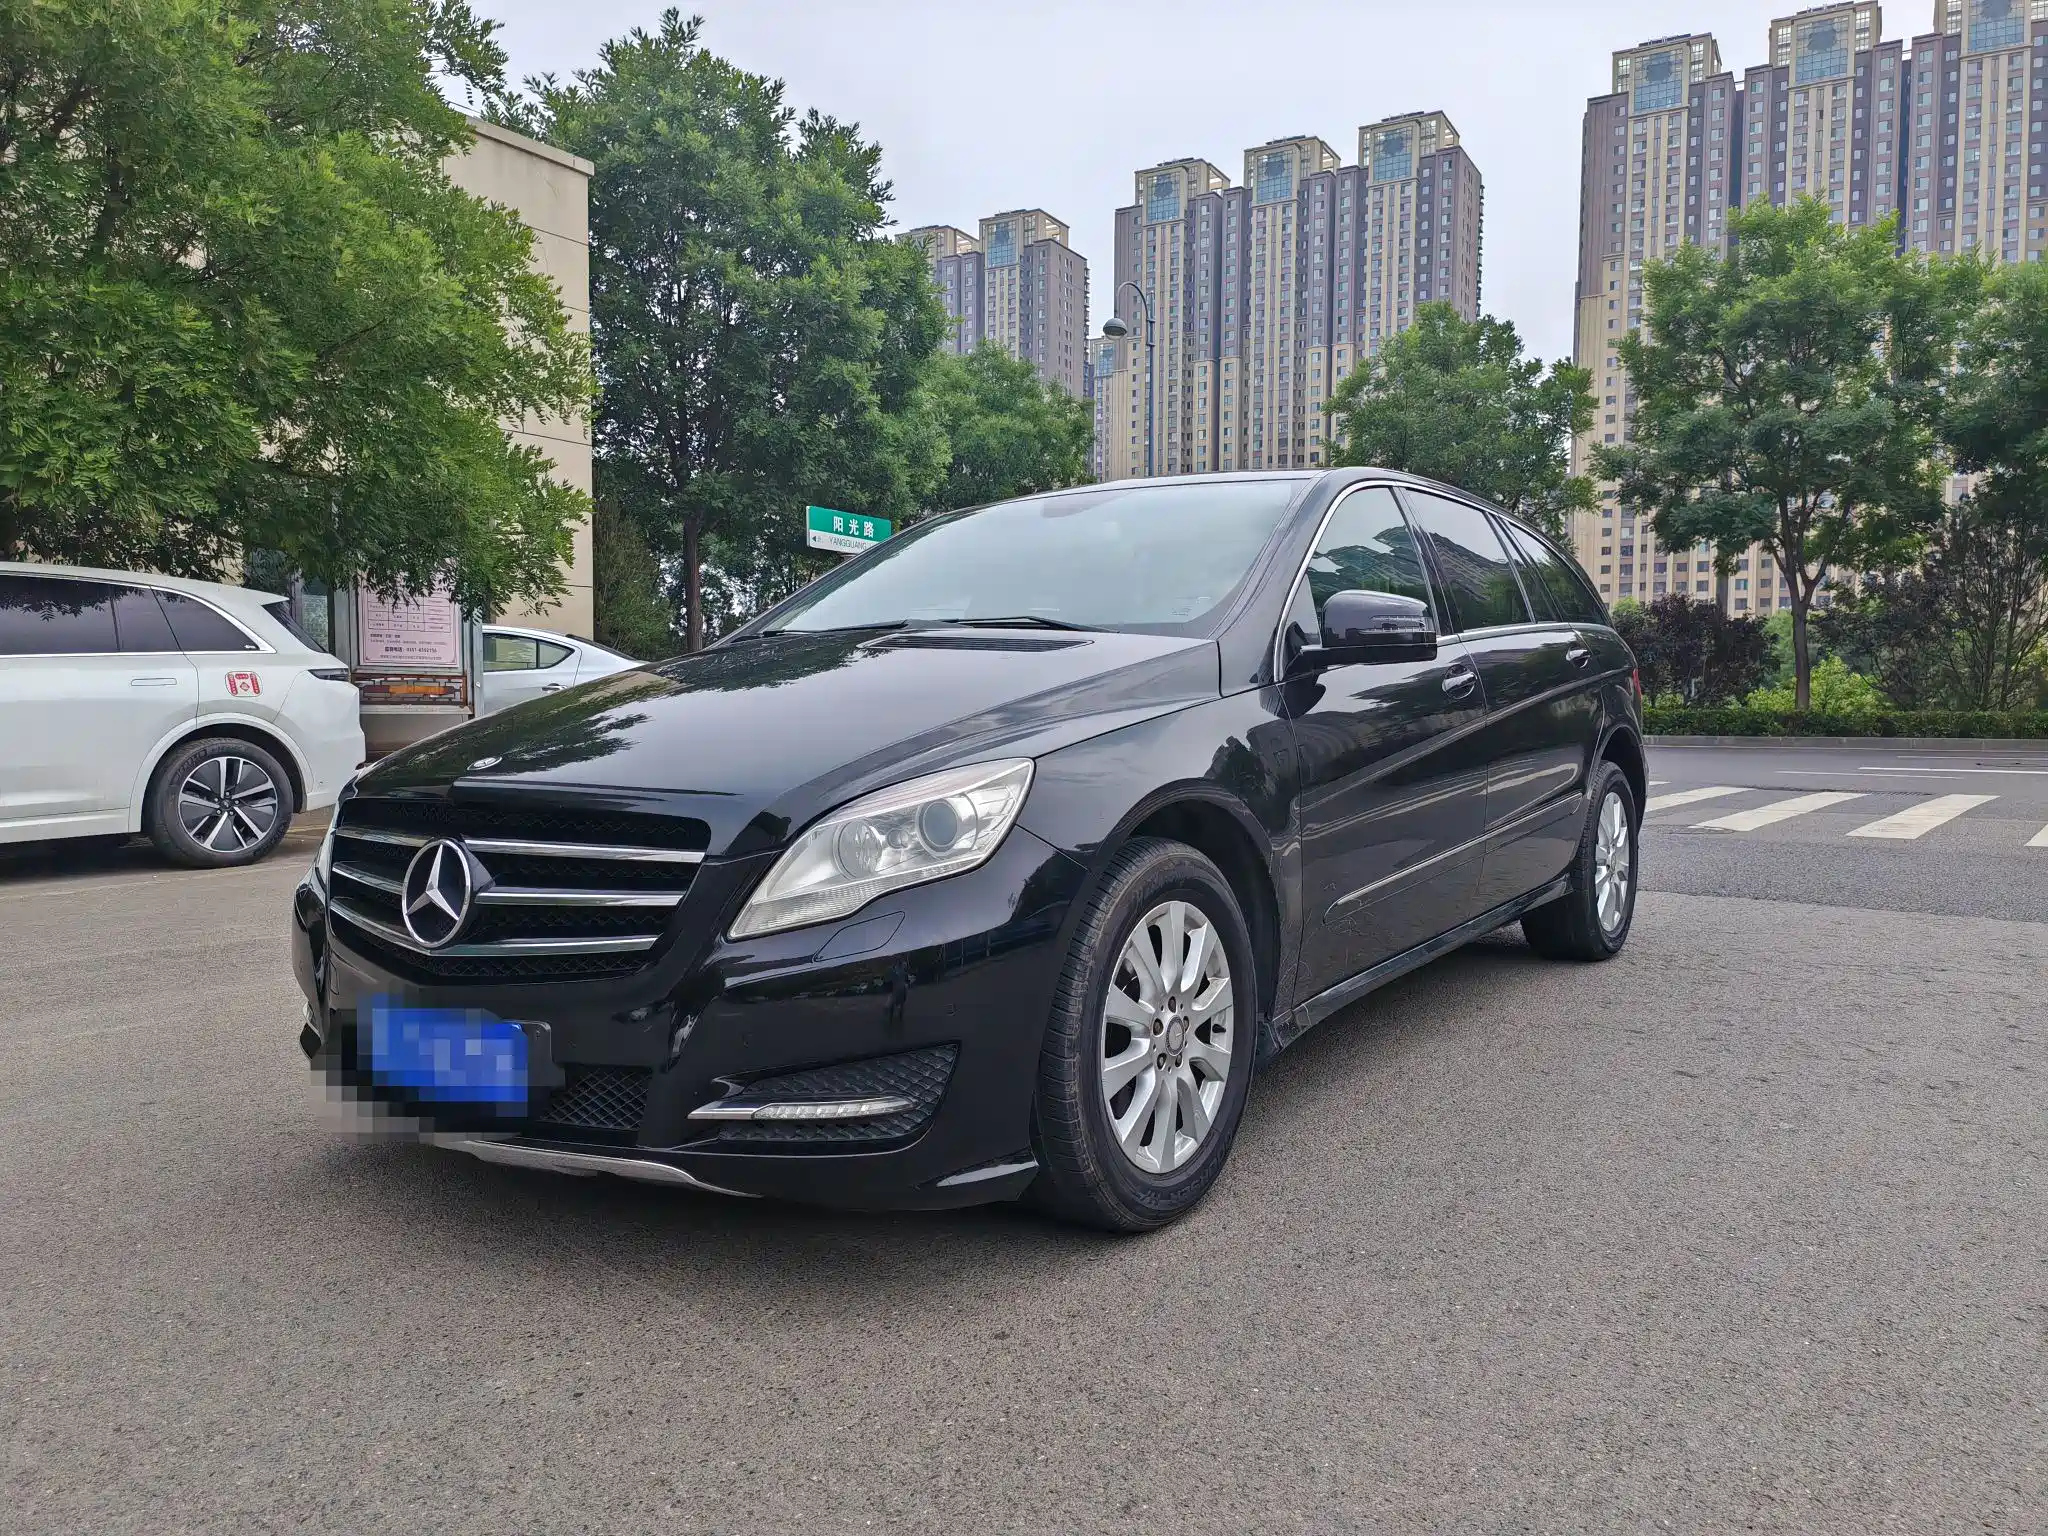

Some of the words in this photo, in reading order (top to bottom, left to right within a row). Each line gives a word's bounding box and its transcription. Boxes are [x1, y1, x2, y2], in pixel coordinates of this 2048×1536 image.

[833, 516, 874, 538] 阳光路
[829, 536, 867, 550] YANGGUANG
